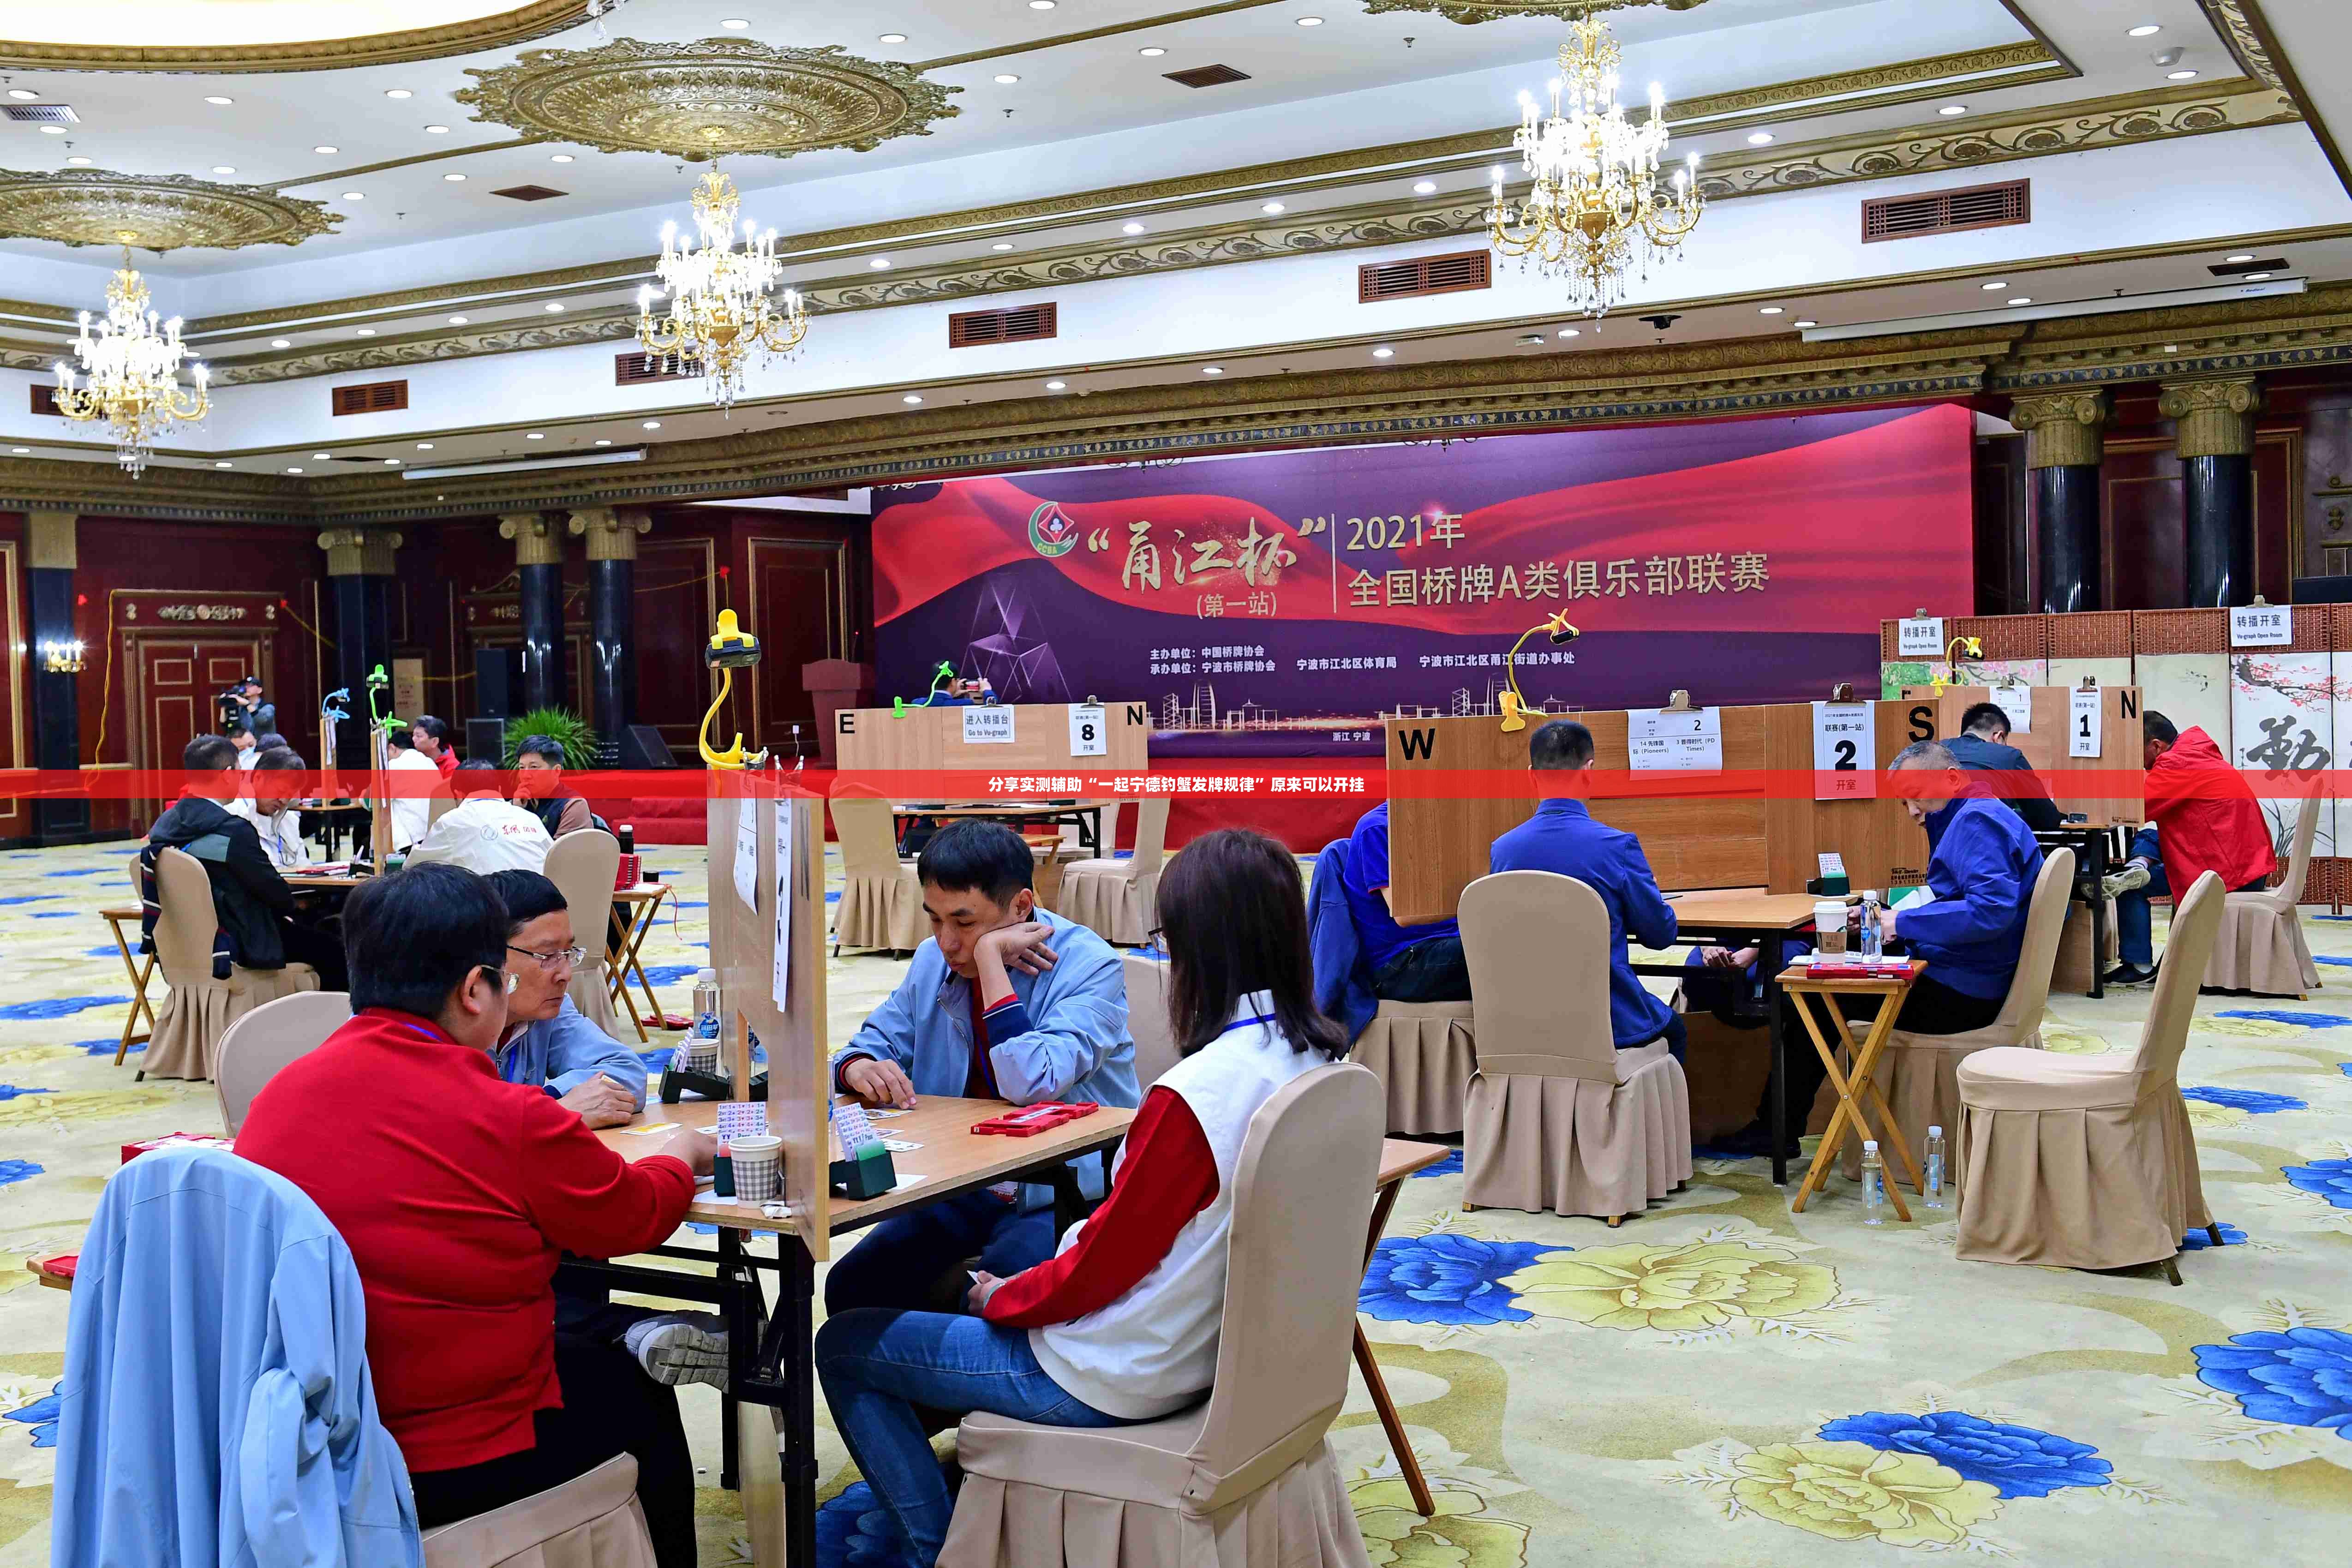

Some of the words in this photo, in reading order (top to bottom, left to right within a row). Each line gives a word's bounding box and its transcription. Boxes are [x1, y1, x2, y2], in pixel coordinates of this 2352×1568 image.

[1347, 511, 1465, 550] 2021年
[1347, 551, 1769, 607] 全国桥牌A类俱乐部联赛
[1197, 591, 1277, 619] (第一站)
[2236, 614, 2281, 628] 转播开室
[1904, 626, 1936, 638] 转播开室
[1297, 656, 1397, 671] 宁波市江北区体育局
[2121, 690, 2136, 719] N
[839, 713, 855, 734] E
[966, 714, 1008, 725] 进入转播台
[1127, 705, 1143, 726] N
[1694, 719, 1701, 731] 2
[1908, 706, 1935, 743] S
[2080, 714, 2091, 737] 1
[1082, 724, 1095, 741] 8
[1333, 732, 1350, 742] 浙江
[1353, 732, 1371, 742] 宁波
[1825, 723, 1864, 732] 联赛(第一站)
[1398, 728, 1436, 760] W
[1834, 740, 1857, 772] 2
